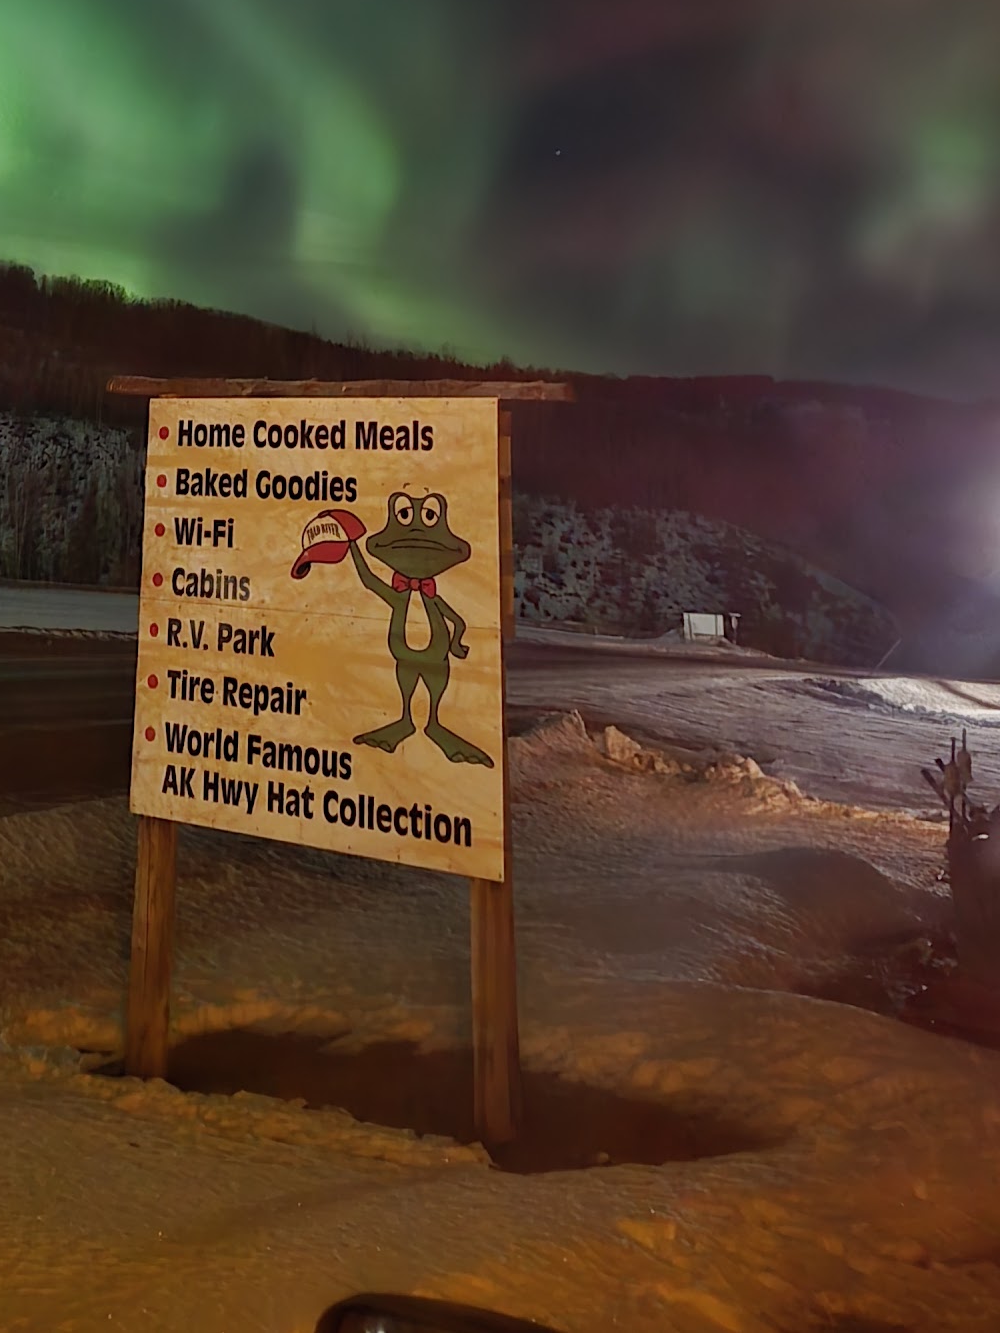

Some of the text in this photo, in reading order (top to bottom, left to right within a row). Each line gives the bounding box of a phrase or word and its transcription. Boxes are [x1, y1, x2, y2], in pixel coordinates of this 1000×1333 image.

[177, 419, 434, 451] Home Cooked Meals
[175, 467, 357, 503] Baked Goodies
[174, 516, 235, 548] Wi-Fi
[171, 567, 250, 600] Cabins
[167, 617, 275, 657] R.V. Park
[167, 669, 307, 716] Tire Repair
[165, 721, 352, 781] World Famous
[161, 764, 472, 848] AK Hwy Hat Collection
